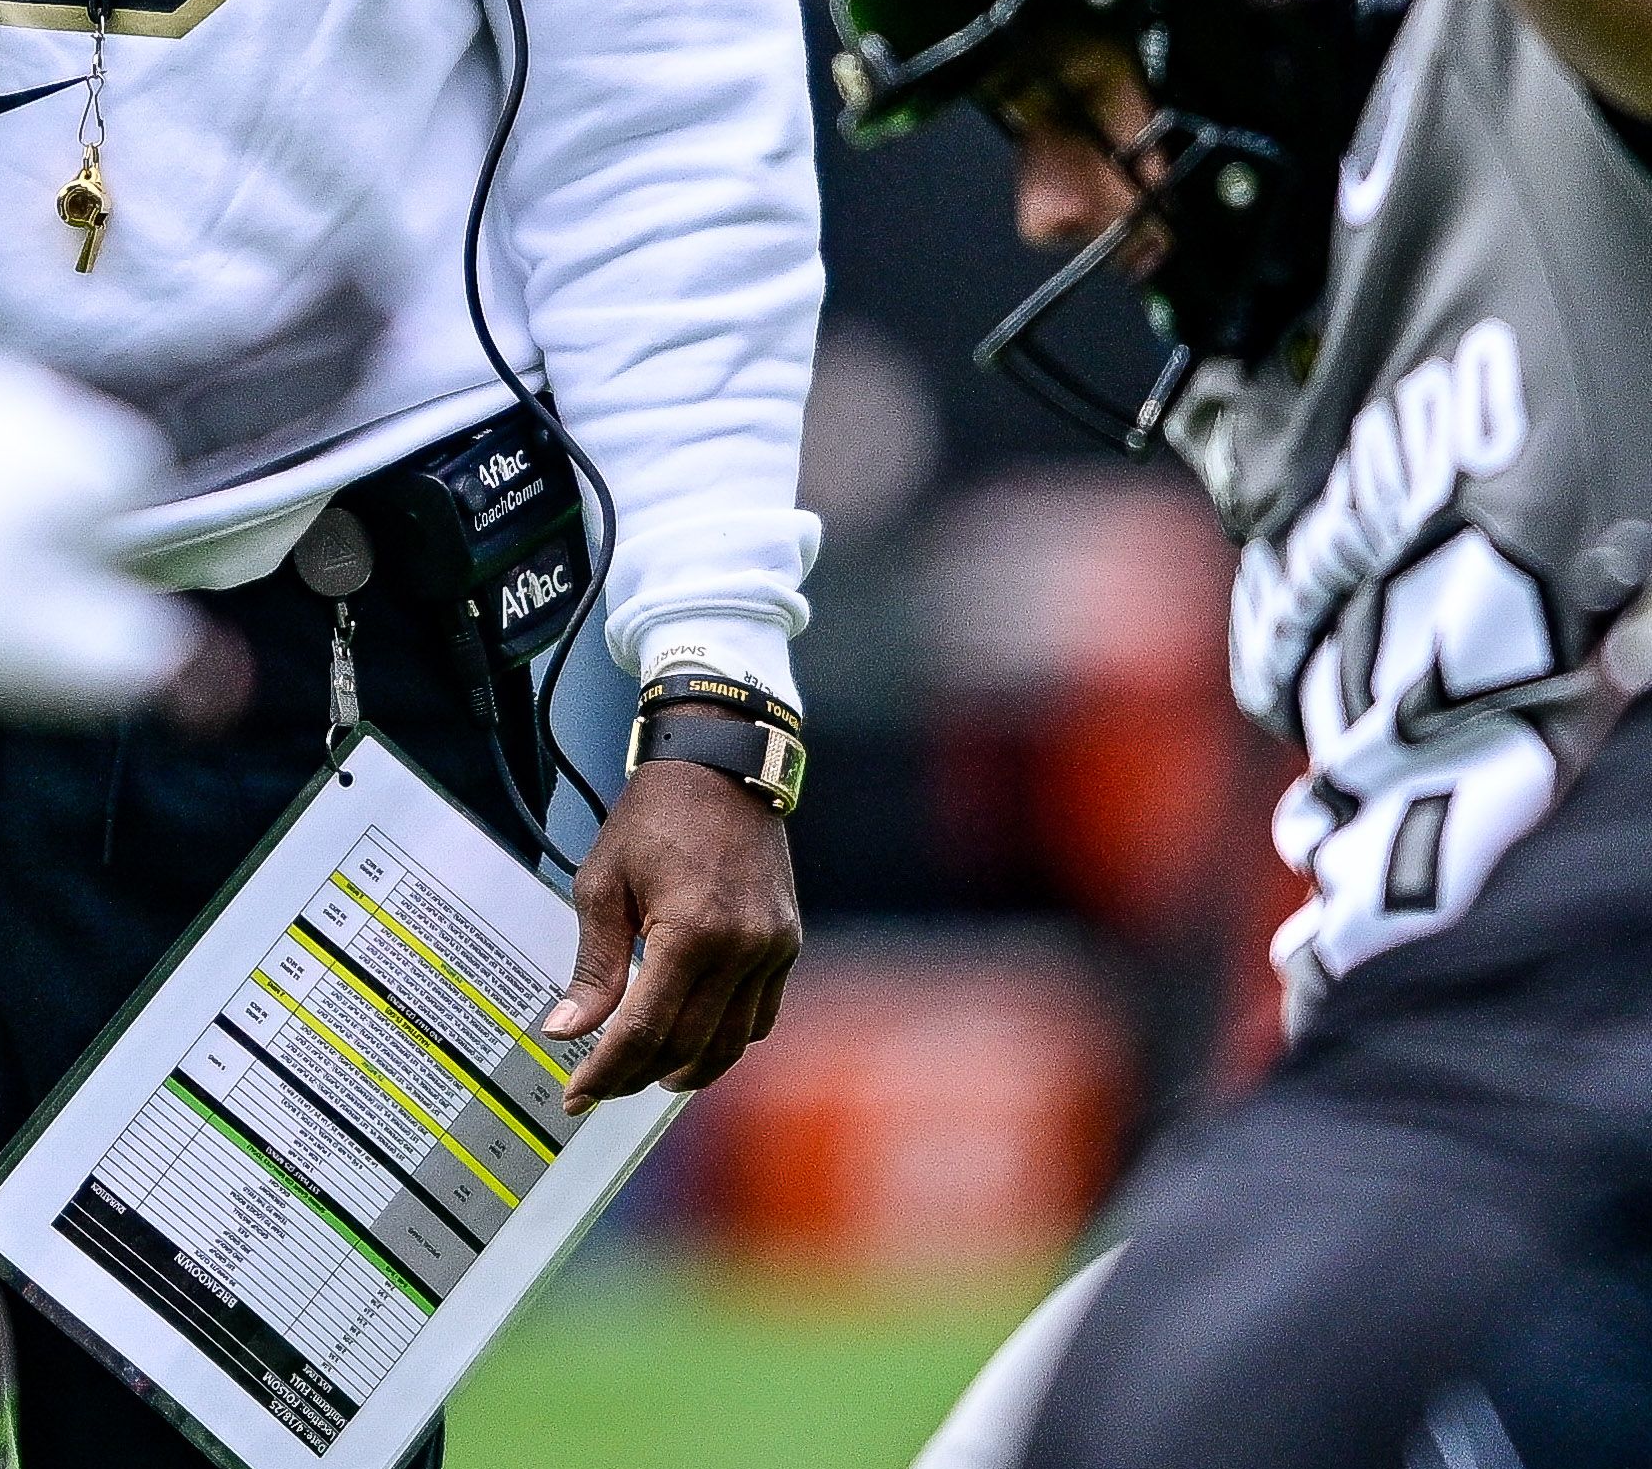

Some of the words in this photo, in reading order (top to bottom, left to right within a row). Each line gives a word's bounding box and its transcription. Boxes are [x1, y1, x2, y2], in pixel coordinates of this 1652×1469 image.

[689, 680, 750, 704] SMART
[88, 1180, 127, 1215] DURATION
[172, 1249, 238, 1309] BREAKDOWN
[260, 1370, 302, 1409] FOLSOM
[286, 1371, 313, 1397] FULL
[266, 1396, 306, 1435] 4/18/25
[295, 1402, 338, 1442] Location:
[305, 1389, 348, 1429] Uniform:
[300, 1427, 328, 1454] Date:
